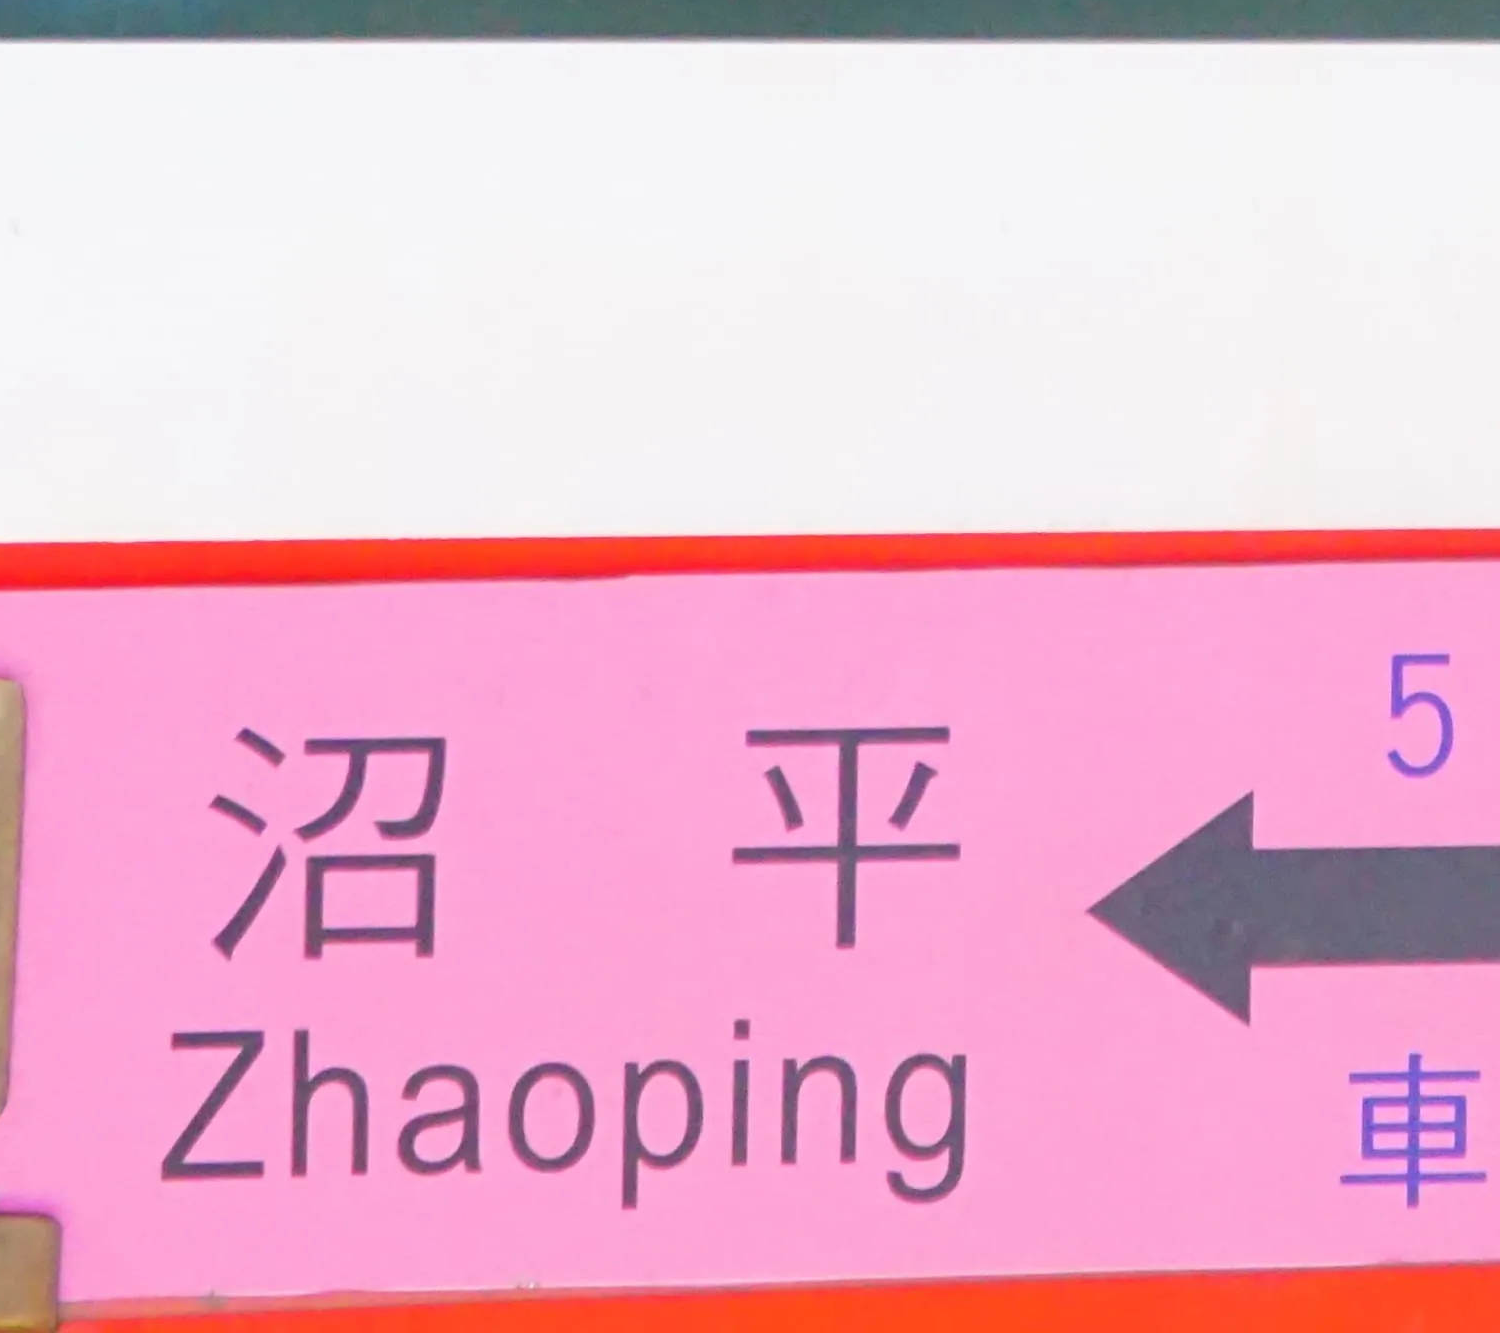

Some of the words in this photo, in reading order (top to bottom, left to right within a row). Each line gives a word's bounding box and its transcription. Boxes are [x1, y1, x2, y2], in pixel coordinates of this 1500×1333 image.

[1387, 653, 1454, 776] 5
[161, 1018, 968, 1206] Zhaoping
[1341, 1052, 1487, 1205] 車
